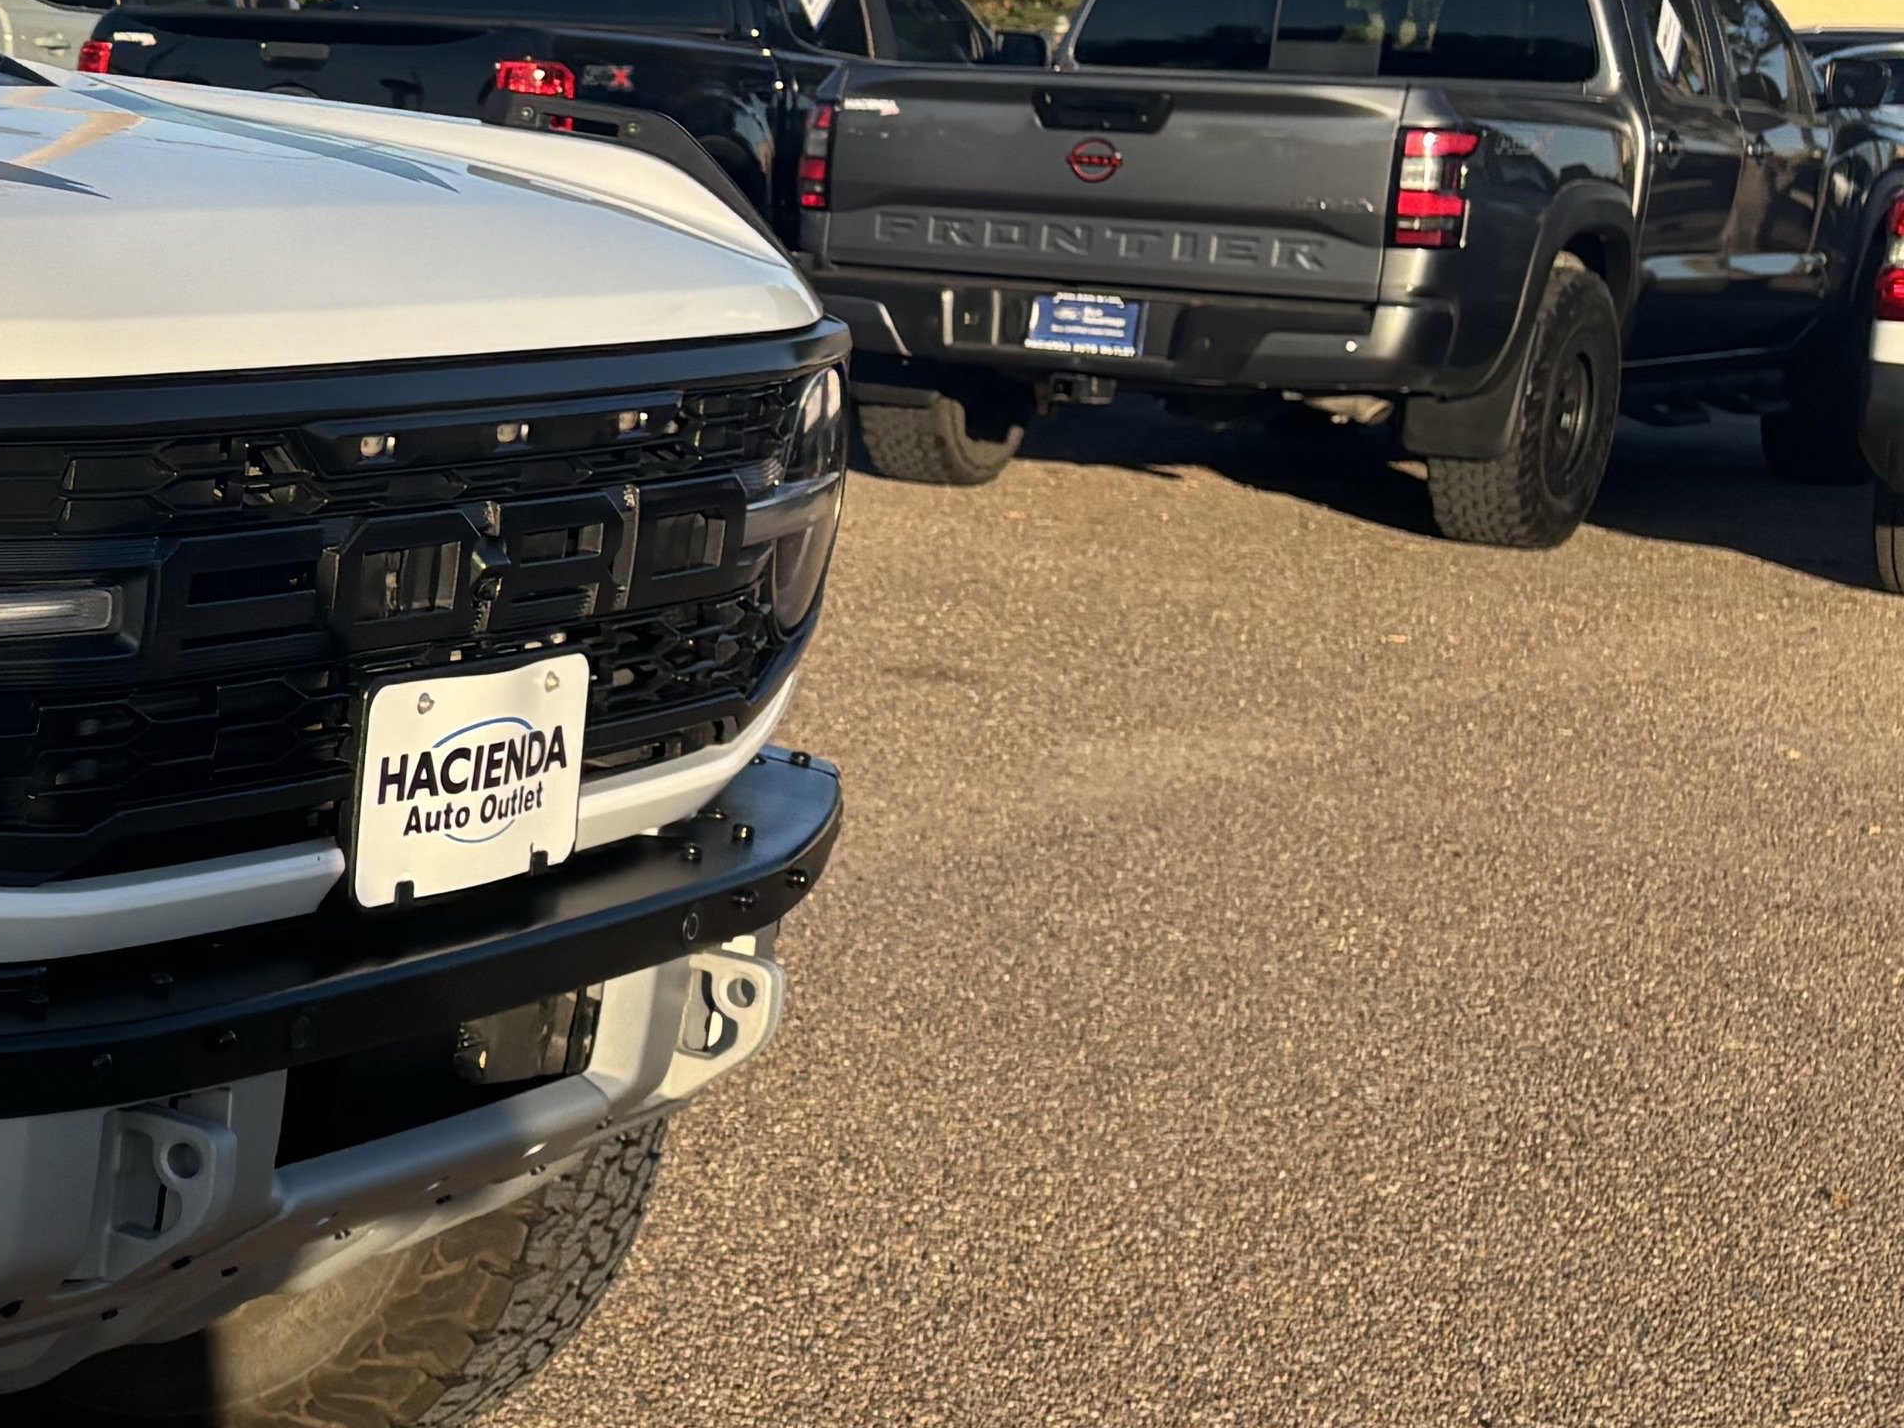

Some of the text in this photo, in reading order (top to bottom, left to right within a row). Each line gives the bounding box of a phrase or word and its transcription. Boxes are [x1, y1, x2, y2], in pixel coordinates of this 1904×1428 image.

[874, 212, 1329, 271] FRONTIER
[377, 725, 567, 805] HACIENDA
[403, 781, 543, 836] Auto Outlet
